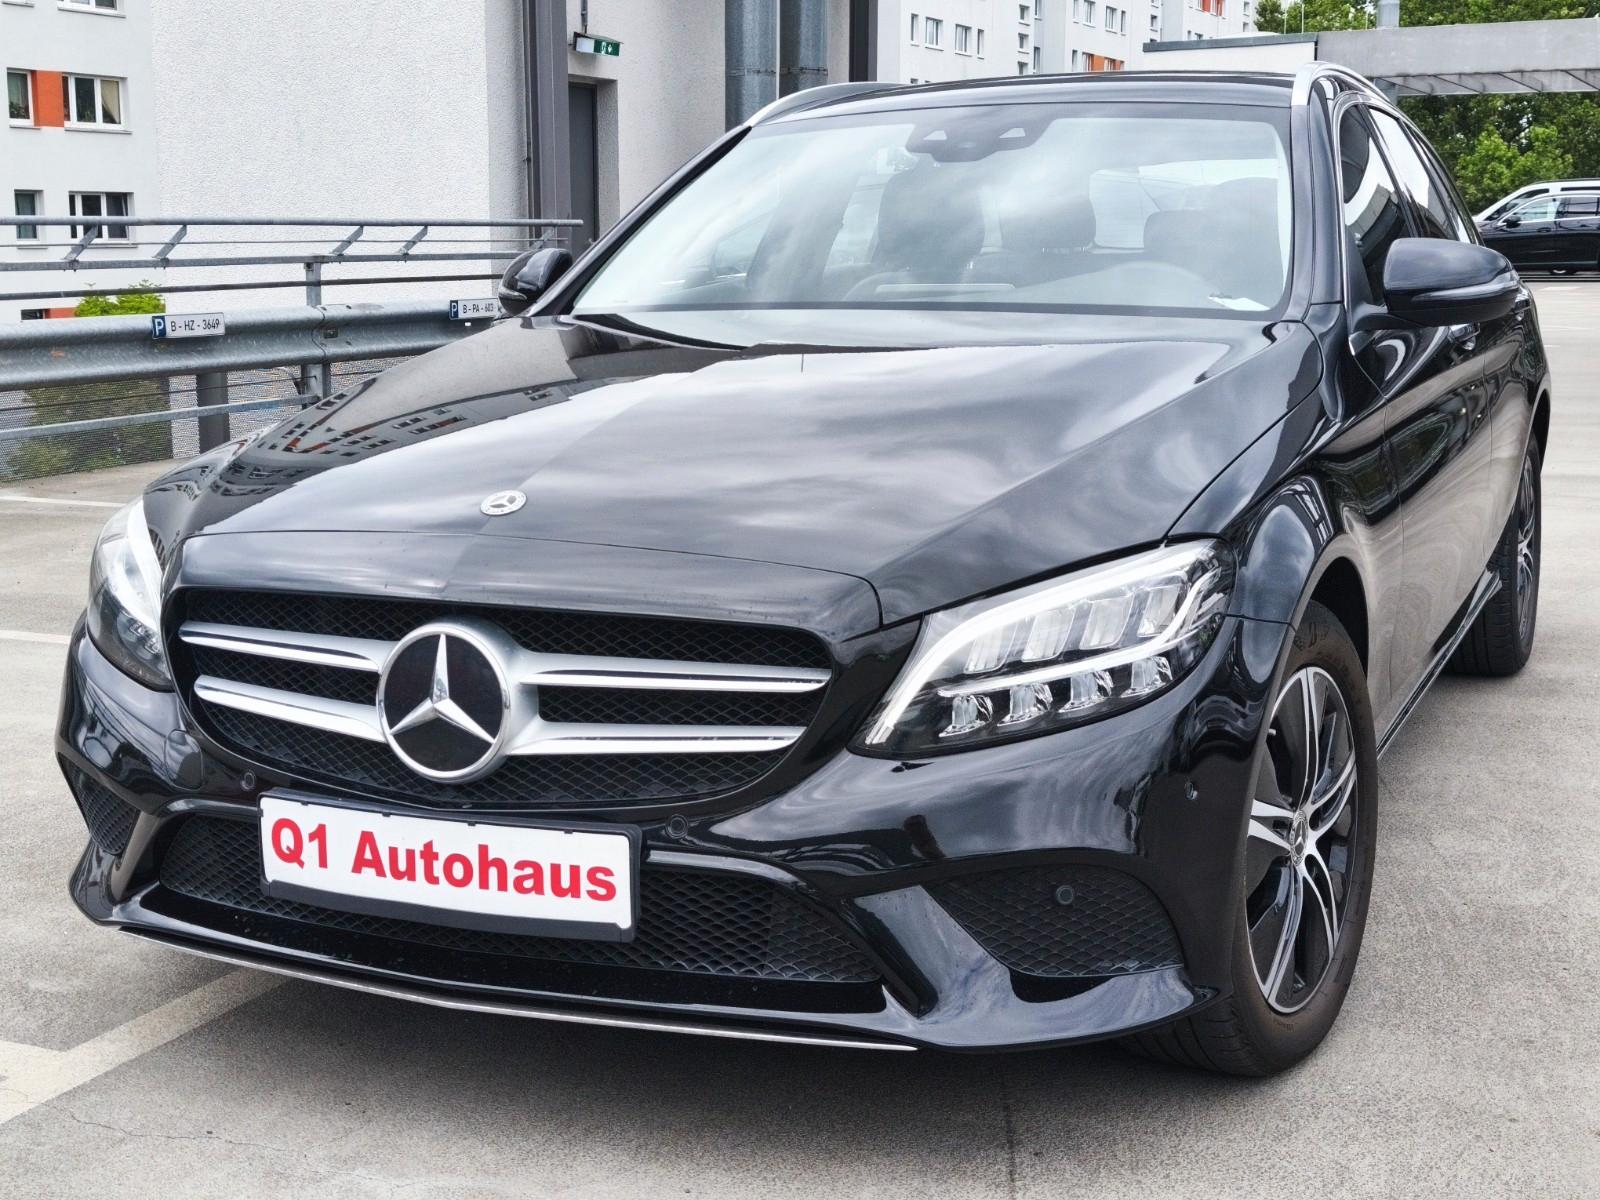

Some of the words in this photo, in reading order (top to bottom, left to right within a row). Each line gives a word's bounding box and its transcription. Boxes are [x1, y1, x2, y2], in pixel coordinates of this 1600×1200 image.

[451, 302, 458, 318] P
[155, 318, 164, 336] P
[271, 817, 328, 869] Q1
[351, 829, 617, 901] Autohaus
